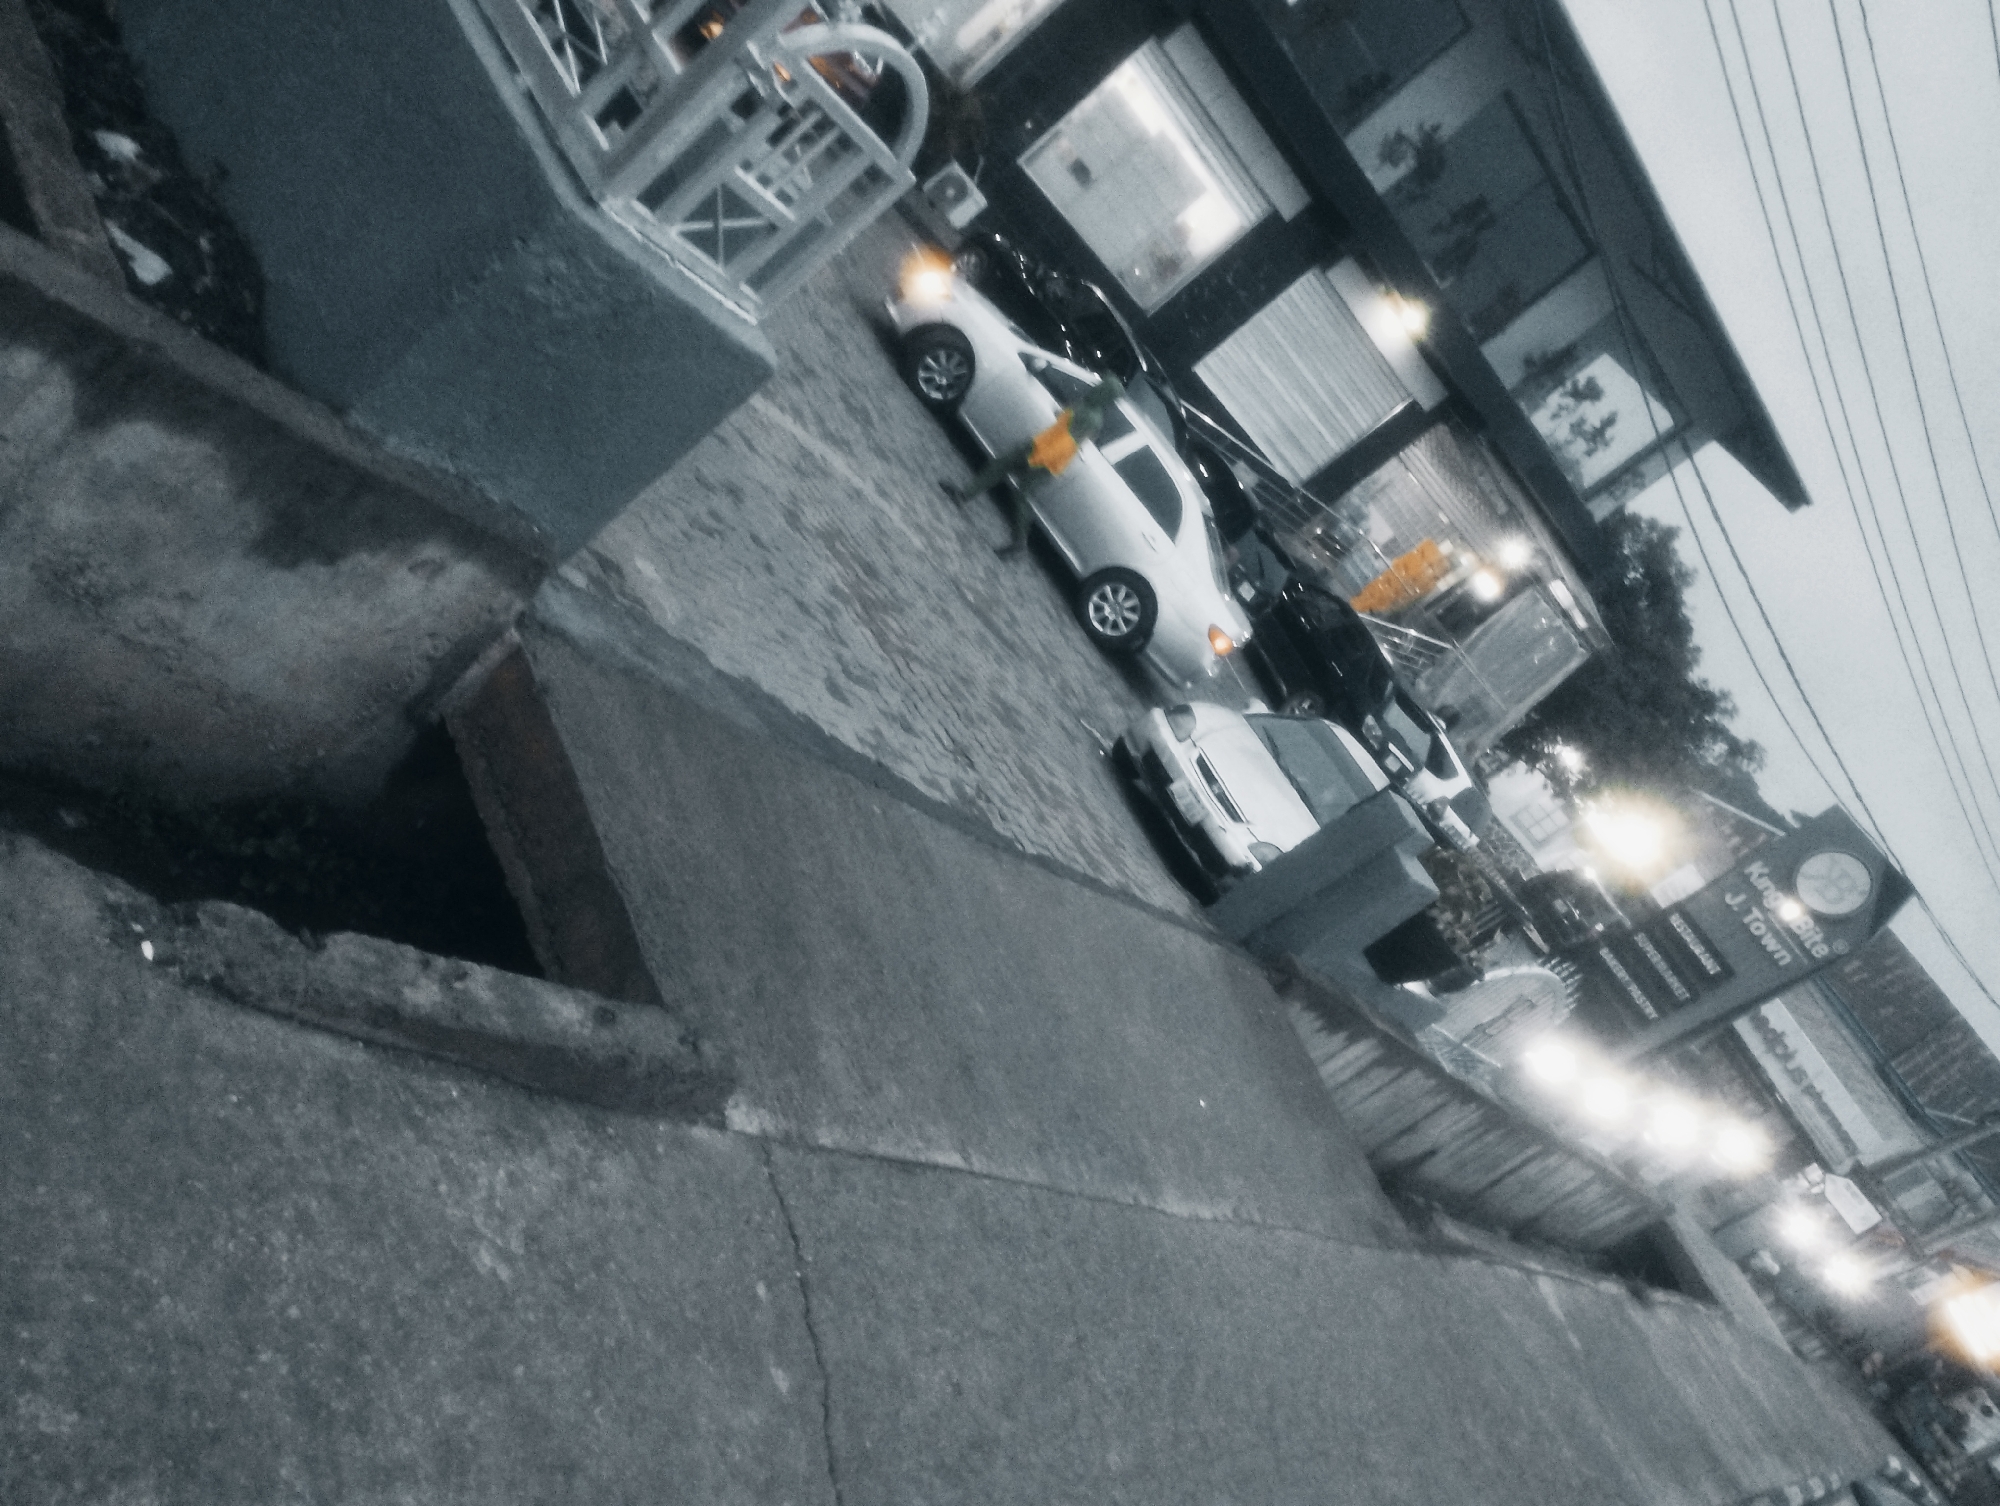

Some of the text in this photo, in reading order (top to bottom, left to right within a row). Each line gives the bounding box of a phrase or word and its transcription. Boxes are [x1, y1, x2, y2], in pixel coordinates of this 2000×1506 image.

[1669, 913, 1721, 974] RESTAURANT
[1724, 892, 1791, 966] J. Town
[1789, 915, 1829, 958] Bite
[1600, 947, 1659, 1019] BAKERY PASTRY
[1634, 932, 1690, 1000] SUPERMARKET
